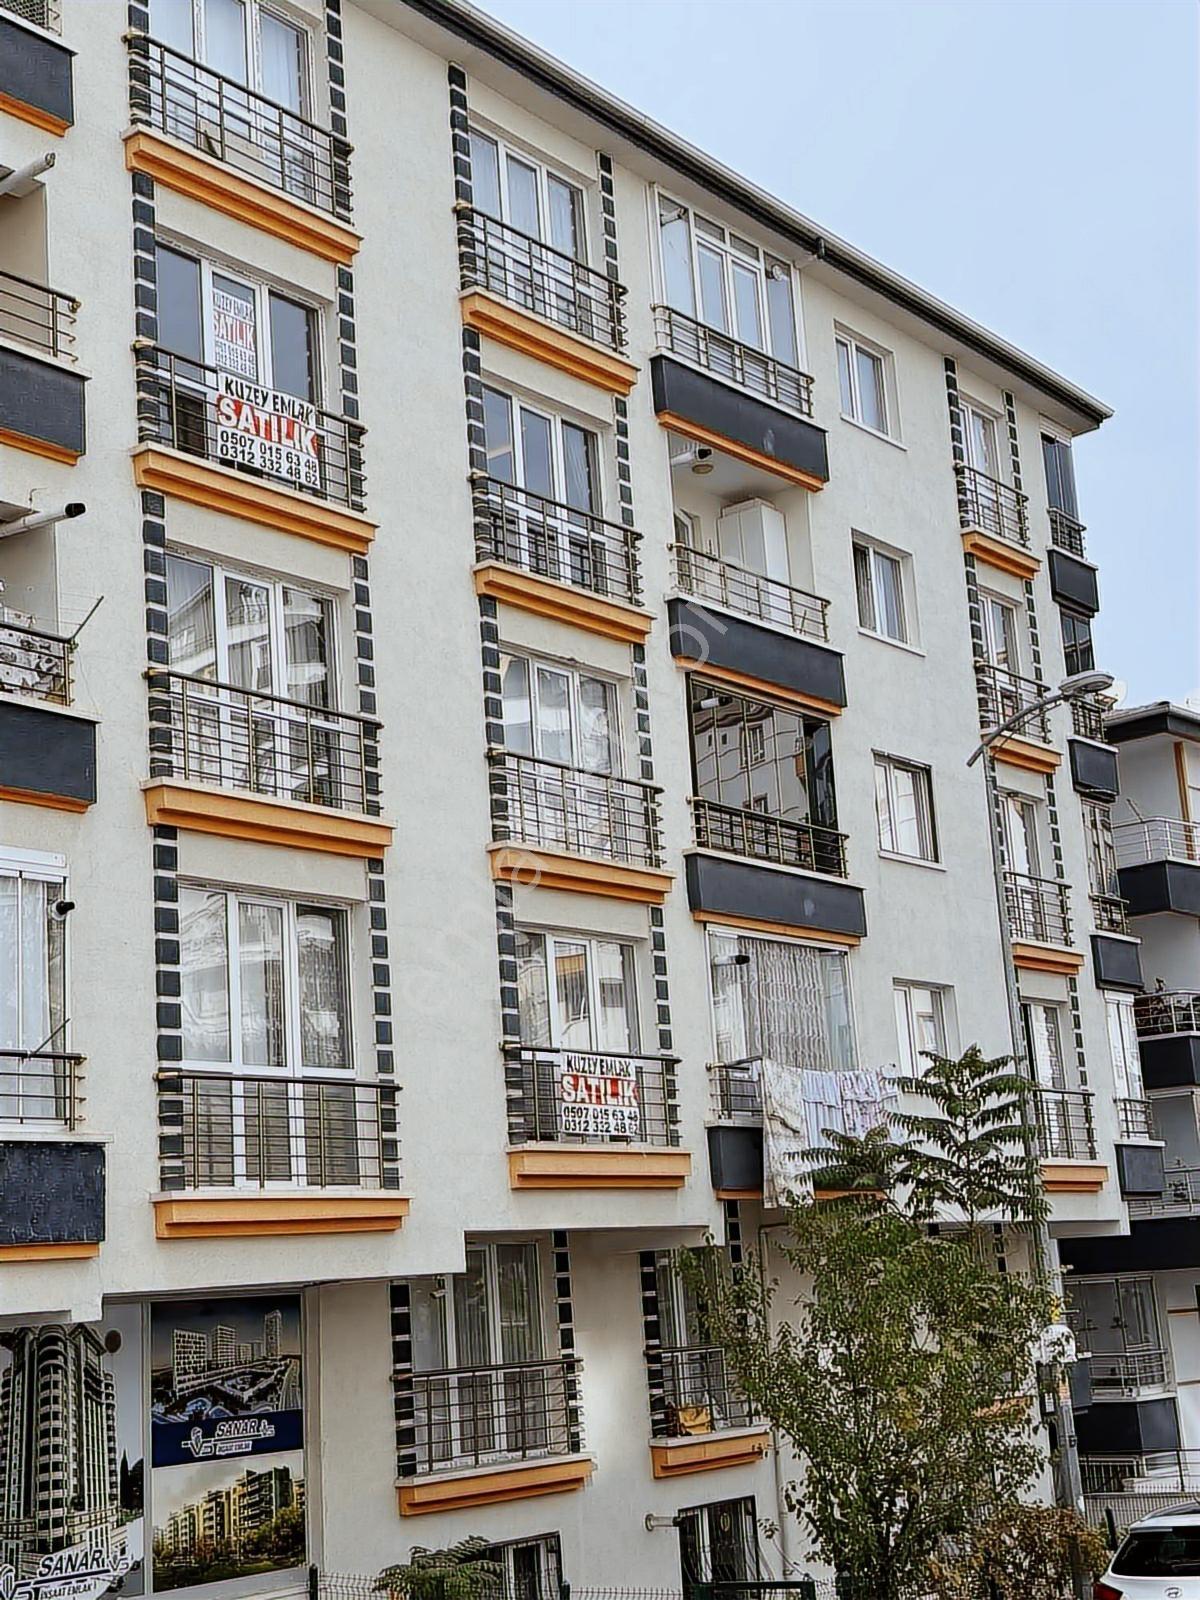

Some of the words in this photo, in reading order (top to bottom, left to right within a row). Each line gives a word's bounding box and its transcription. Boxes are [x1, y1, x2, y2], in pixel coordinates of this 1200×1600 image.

[213, 311, 255, 351] SATILIK
[224, 376, 269, 409] KUZEY
[272, 394, 314, 426] EMLAK
[217, 396, 318, 458] SATILIK
[220, 430, 255, 450] 0507
[259, 442, 282, 460] 015
[285, 448, 300, 467] 63
[304, 454, 318, 473] 48
[220, 444, 255, 465] 0312
[259, 456, 282, 475] 332
[286, 462, 300, 480] 48
[304, 468, 319, 486] 62
[600, 1058, 631, 1077] EMLAK
[562, 1075, 638, 1107] SATILIK
[563, 1106, 590, 1119] 0507
[592, 1108, 610, 1120] 015
[612, 1109, 625, 1121] 63
[564, 1119, 590, 1132] 0312
[613, 1121, 627, 1134] 48
[216, 1419, 258, 1437] SANAR
[38, 1549, 105, 1577] SANAR
